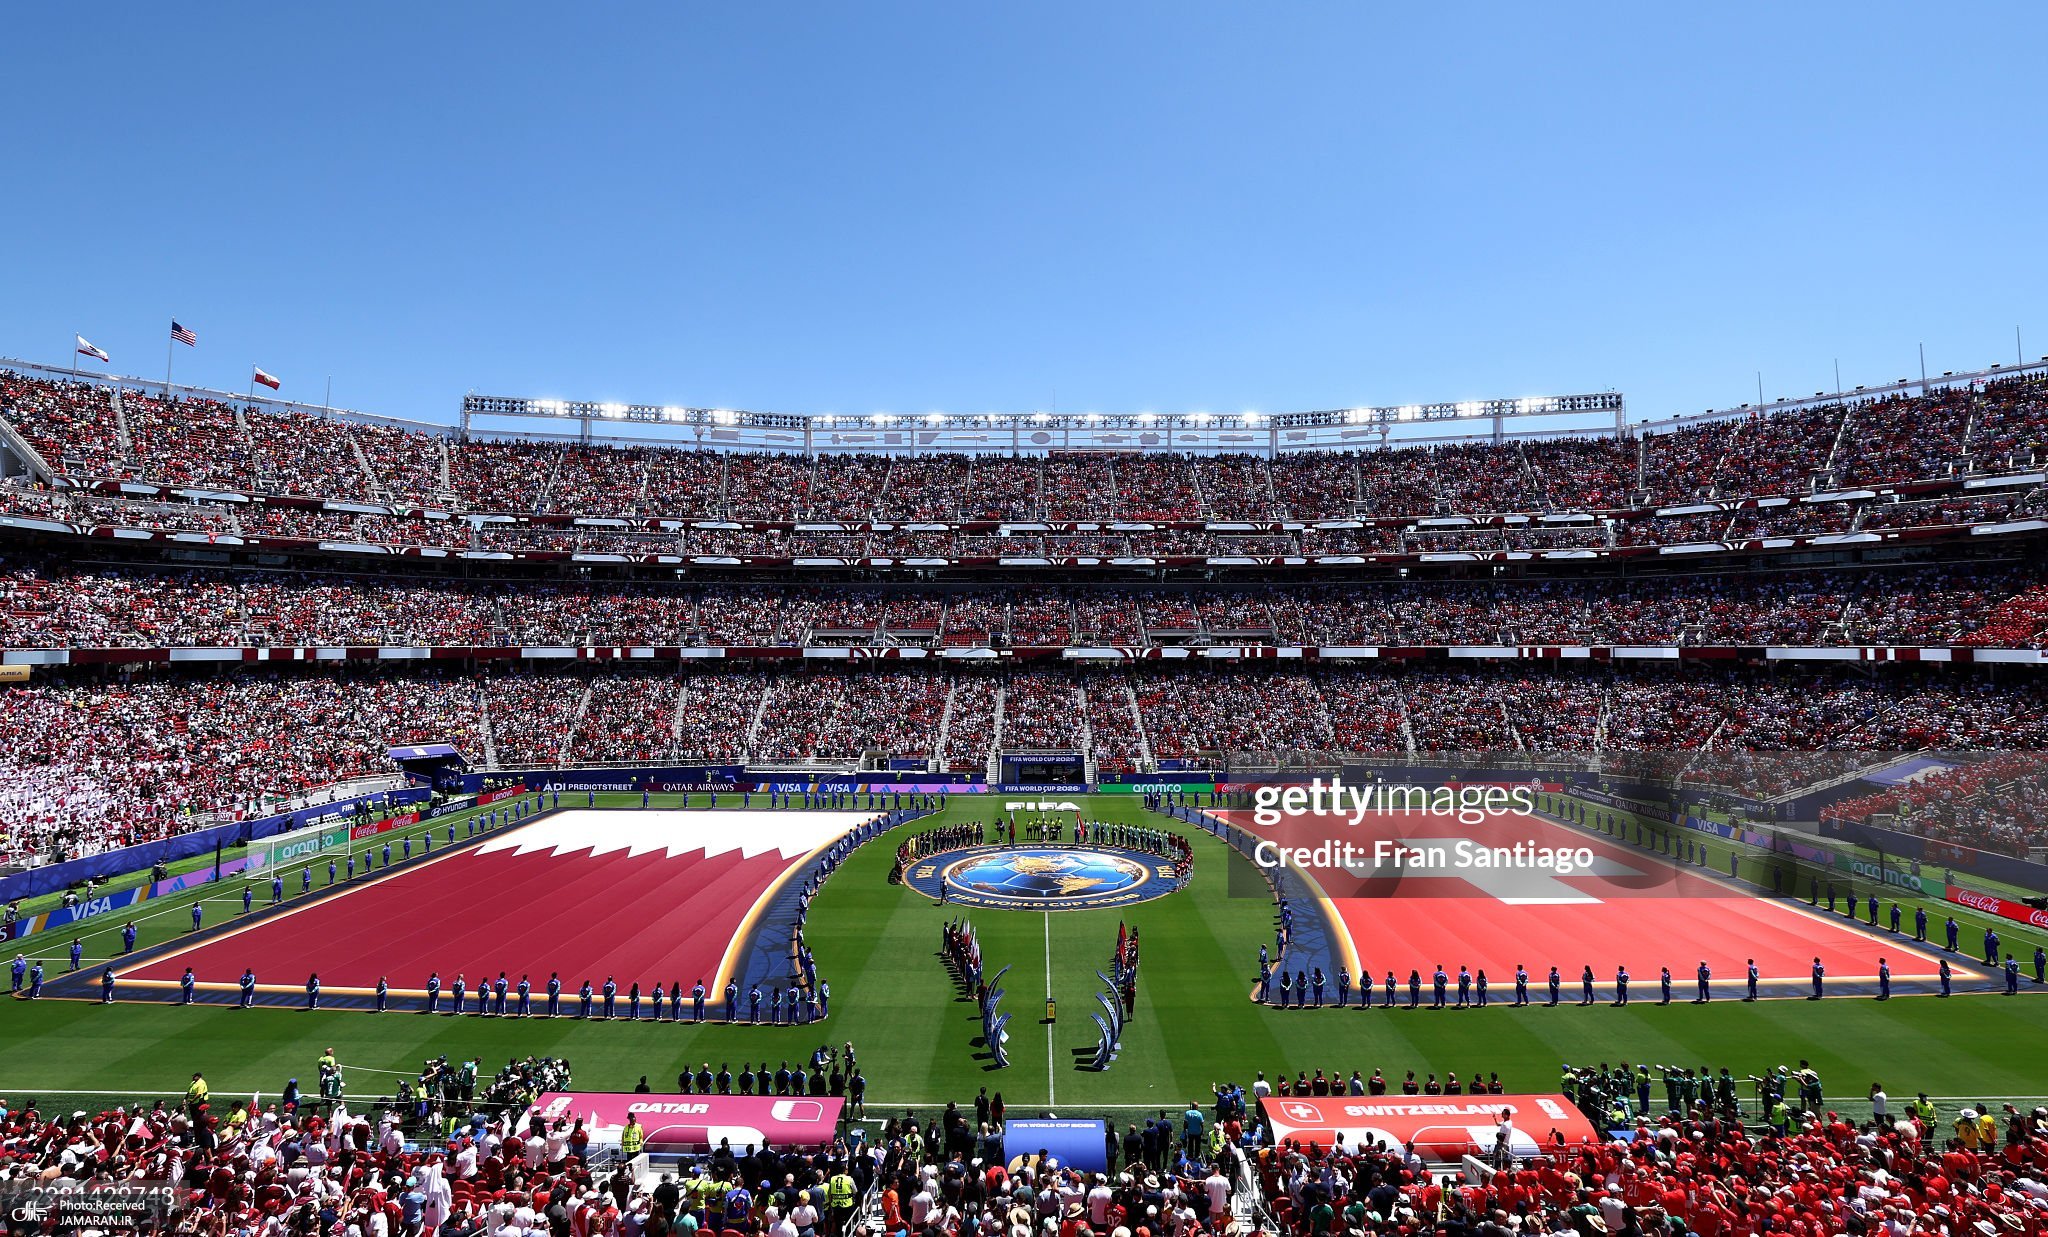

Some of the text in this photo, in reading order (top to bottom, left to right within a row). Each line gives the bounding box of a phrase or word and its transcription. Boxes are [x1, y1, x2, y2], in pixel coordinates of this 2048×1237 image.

[544, 783, 566, 791] ADI
[662, 784, 692, 792] QATAR
[778, 784, 800, 792] VISA
[826, 784, 850, 792] VISA
[1133, 784, 1181, 792] aramco
[1569, 787, 1579, 795] ADI
[492, 790, 513, 801] Lenovo
[341, 804, 355, 813] FIFA
[442, 801, 468, 813] HYUNDAI
[1005, 802, 1080, 812] FIFA
[1616, 800, 1670, 820] QATAR AIRWAYS
[1696, 819, 1718, 835] VISA
[67, 897, 112, 920] VISA
[628, 1102, 710, 1114] QATAR
[1344, 1104, 1518, 1116] SWITZERLAND
